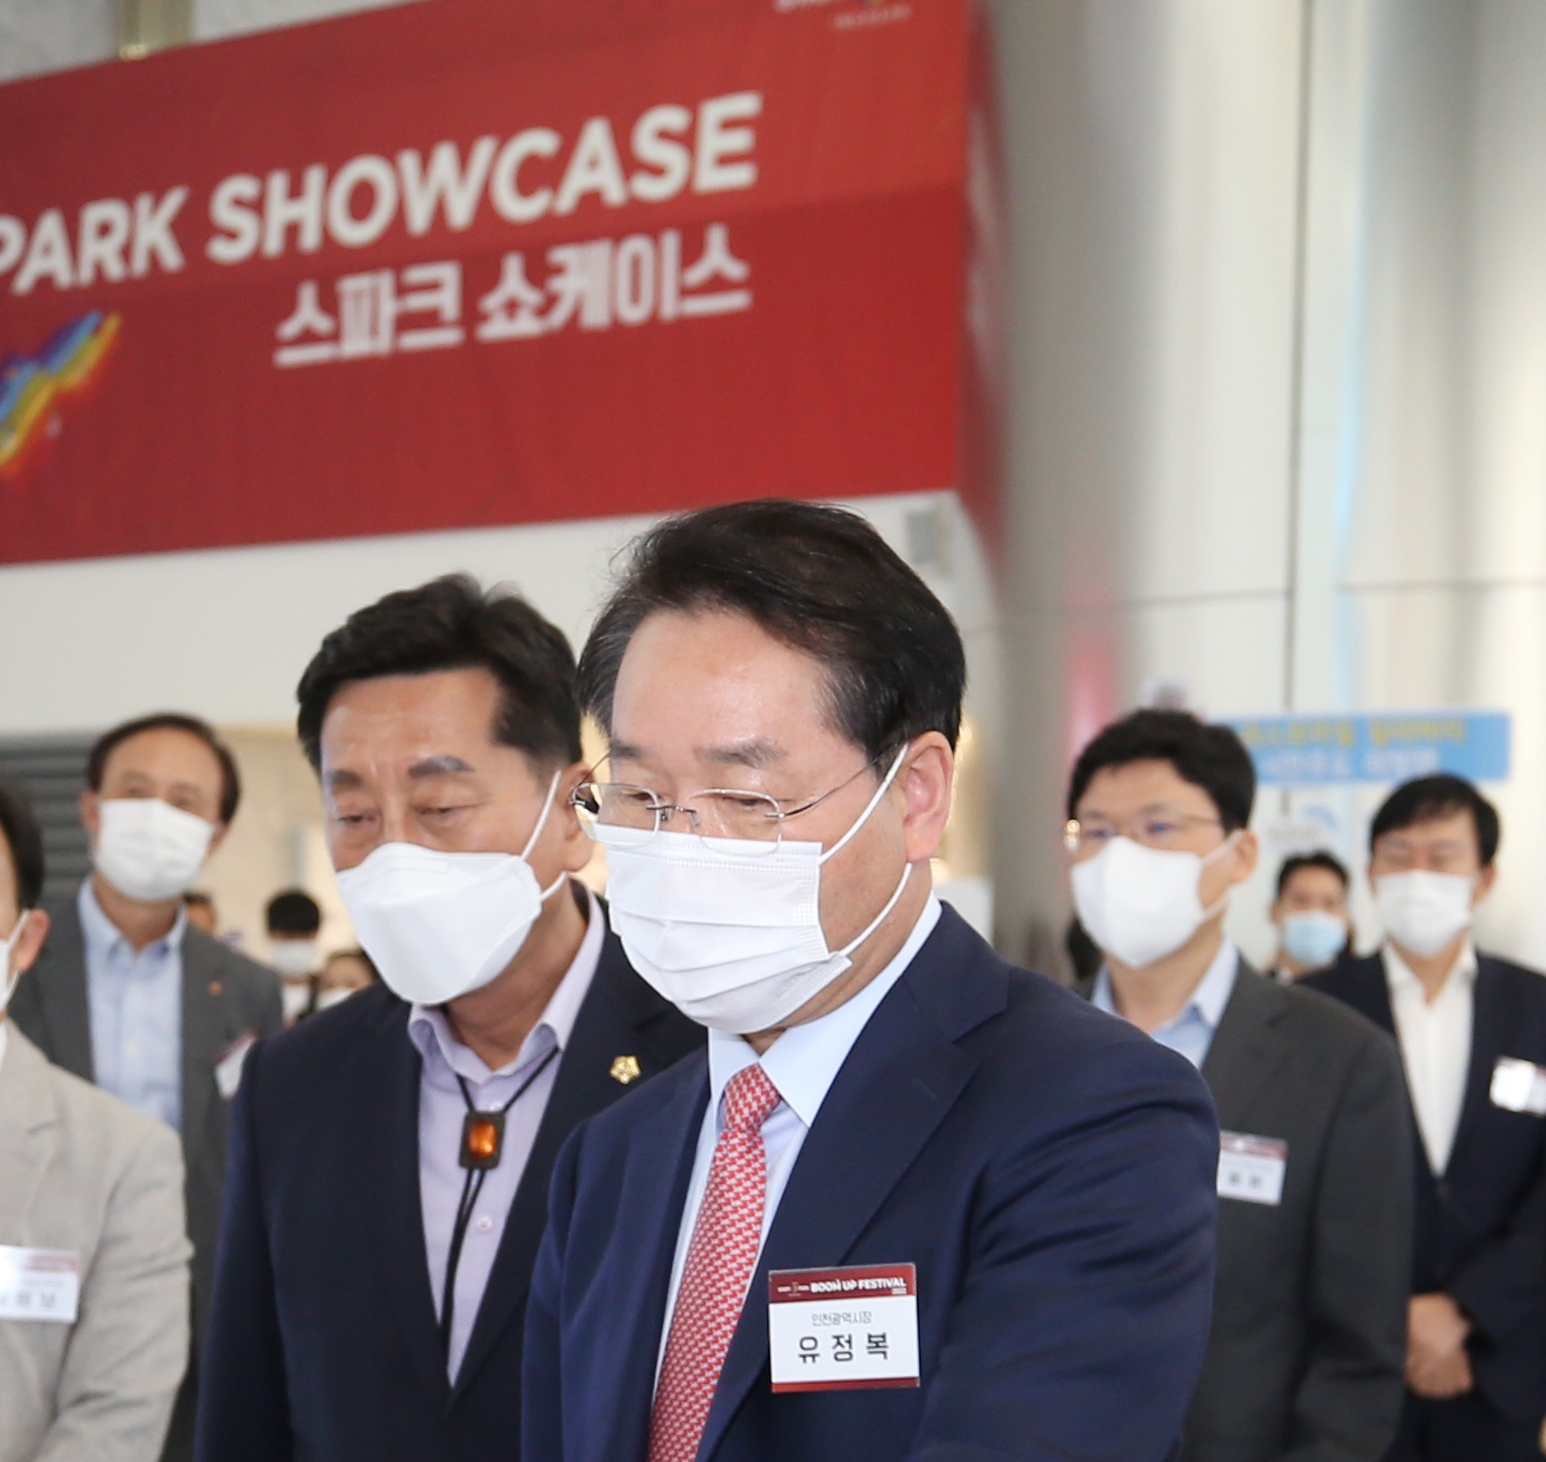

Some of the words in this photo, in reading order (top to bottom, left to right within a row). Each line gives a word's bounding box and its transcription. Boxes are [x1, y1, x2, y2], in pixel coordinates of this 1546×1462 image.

[207, 92, 764, 264] SHOWCASE
[273, 262, 465, 367] 스파크
[476, 223, 752, 343] 쇼케이스
[810, 1278, 842, 1293] BOOM
[842, 1278, 858, 1291] UP
[858, 1277, 907, 1290] FESTIVAL
[811, 1311, 872, 1327] 인천광역시장
